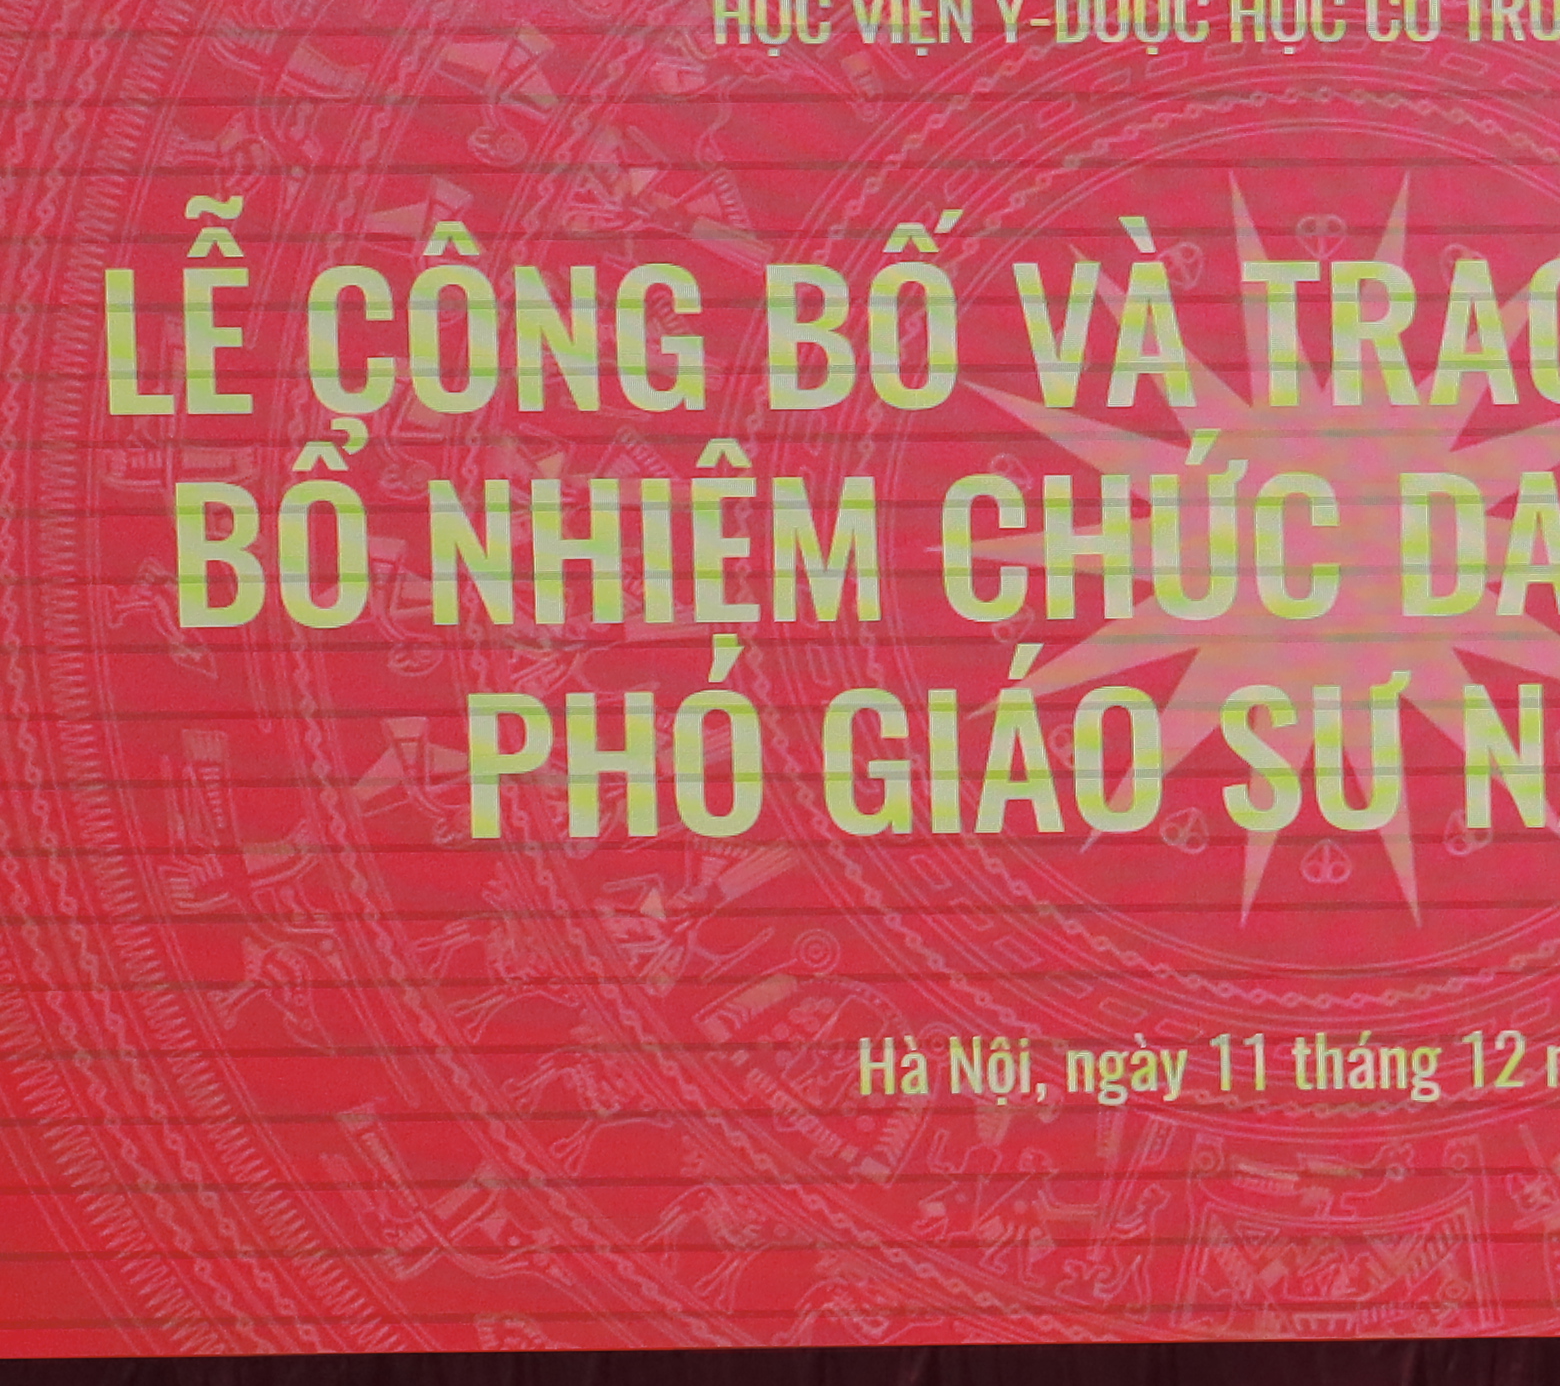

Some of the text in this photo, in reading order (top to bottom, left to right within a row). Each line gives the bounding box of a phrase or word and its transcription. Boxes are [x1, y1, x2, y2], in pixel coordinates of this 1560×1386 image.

[105, 196, 253, 415] LỄ
[308, 221, 705, 415] CÔNG
[766, 209, 963, 410] BỐ
[1013, 216, 1199, 412] VÀ
[175, 417, 369, 628] BỔ
[942, 428, 1342, 621] CHỨC
[468, 634, 763, 838] PHÓ
[822, 640, 1168, 835] GIÁO
[1219, 669, 1412, 833] SƯ
[860, 1036, 928, 1095] Hà
[950, 1036, 1046, 1105] Nội,
[1066, 1033, 1187, 1106] ngày
[1211, 1033, 1266, 1091] 11
[1292, 1030, 1442, 1102] tháng
[1463, 1030, 1525, 1089] 12
